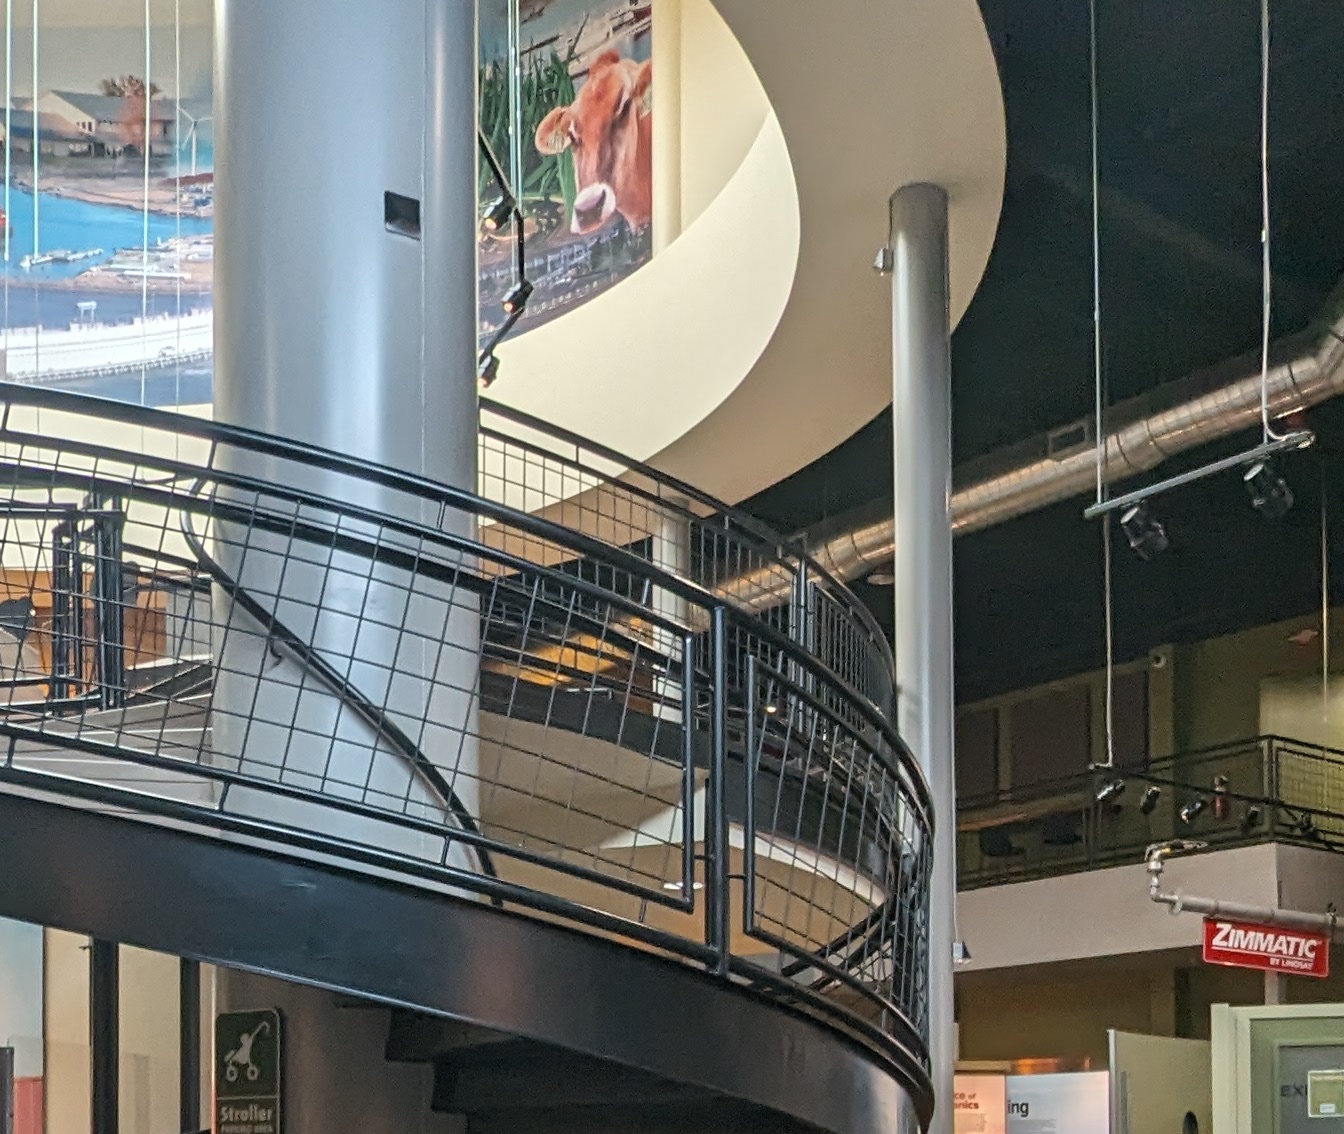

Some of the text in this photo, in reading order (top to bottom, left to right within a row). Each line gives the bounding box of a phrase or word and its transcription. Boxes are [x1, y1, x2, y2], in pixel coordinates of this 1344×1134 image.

[1212, 922, 1317, 959] ZIMMATIC
[1280, 1082, 1308, 1098] EXI
[220, 1103, 273, 1123] Stroller
[1007, 1099, 1029, 1118] ing
